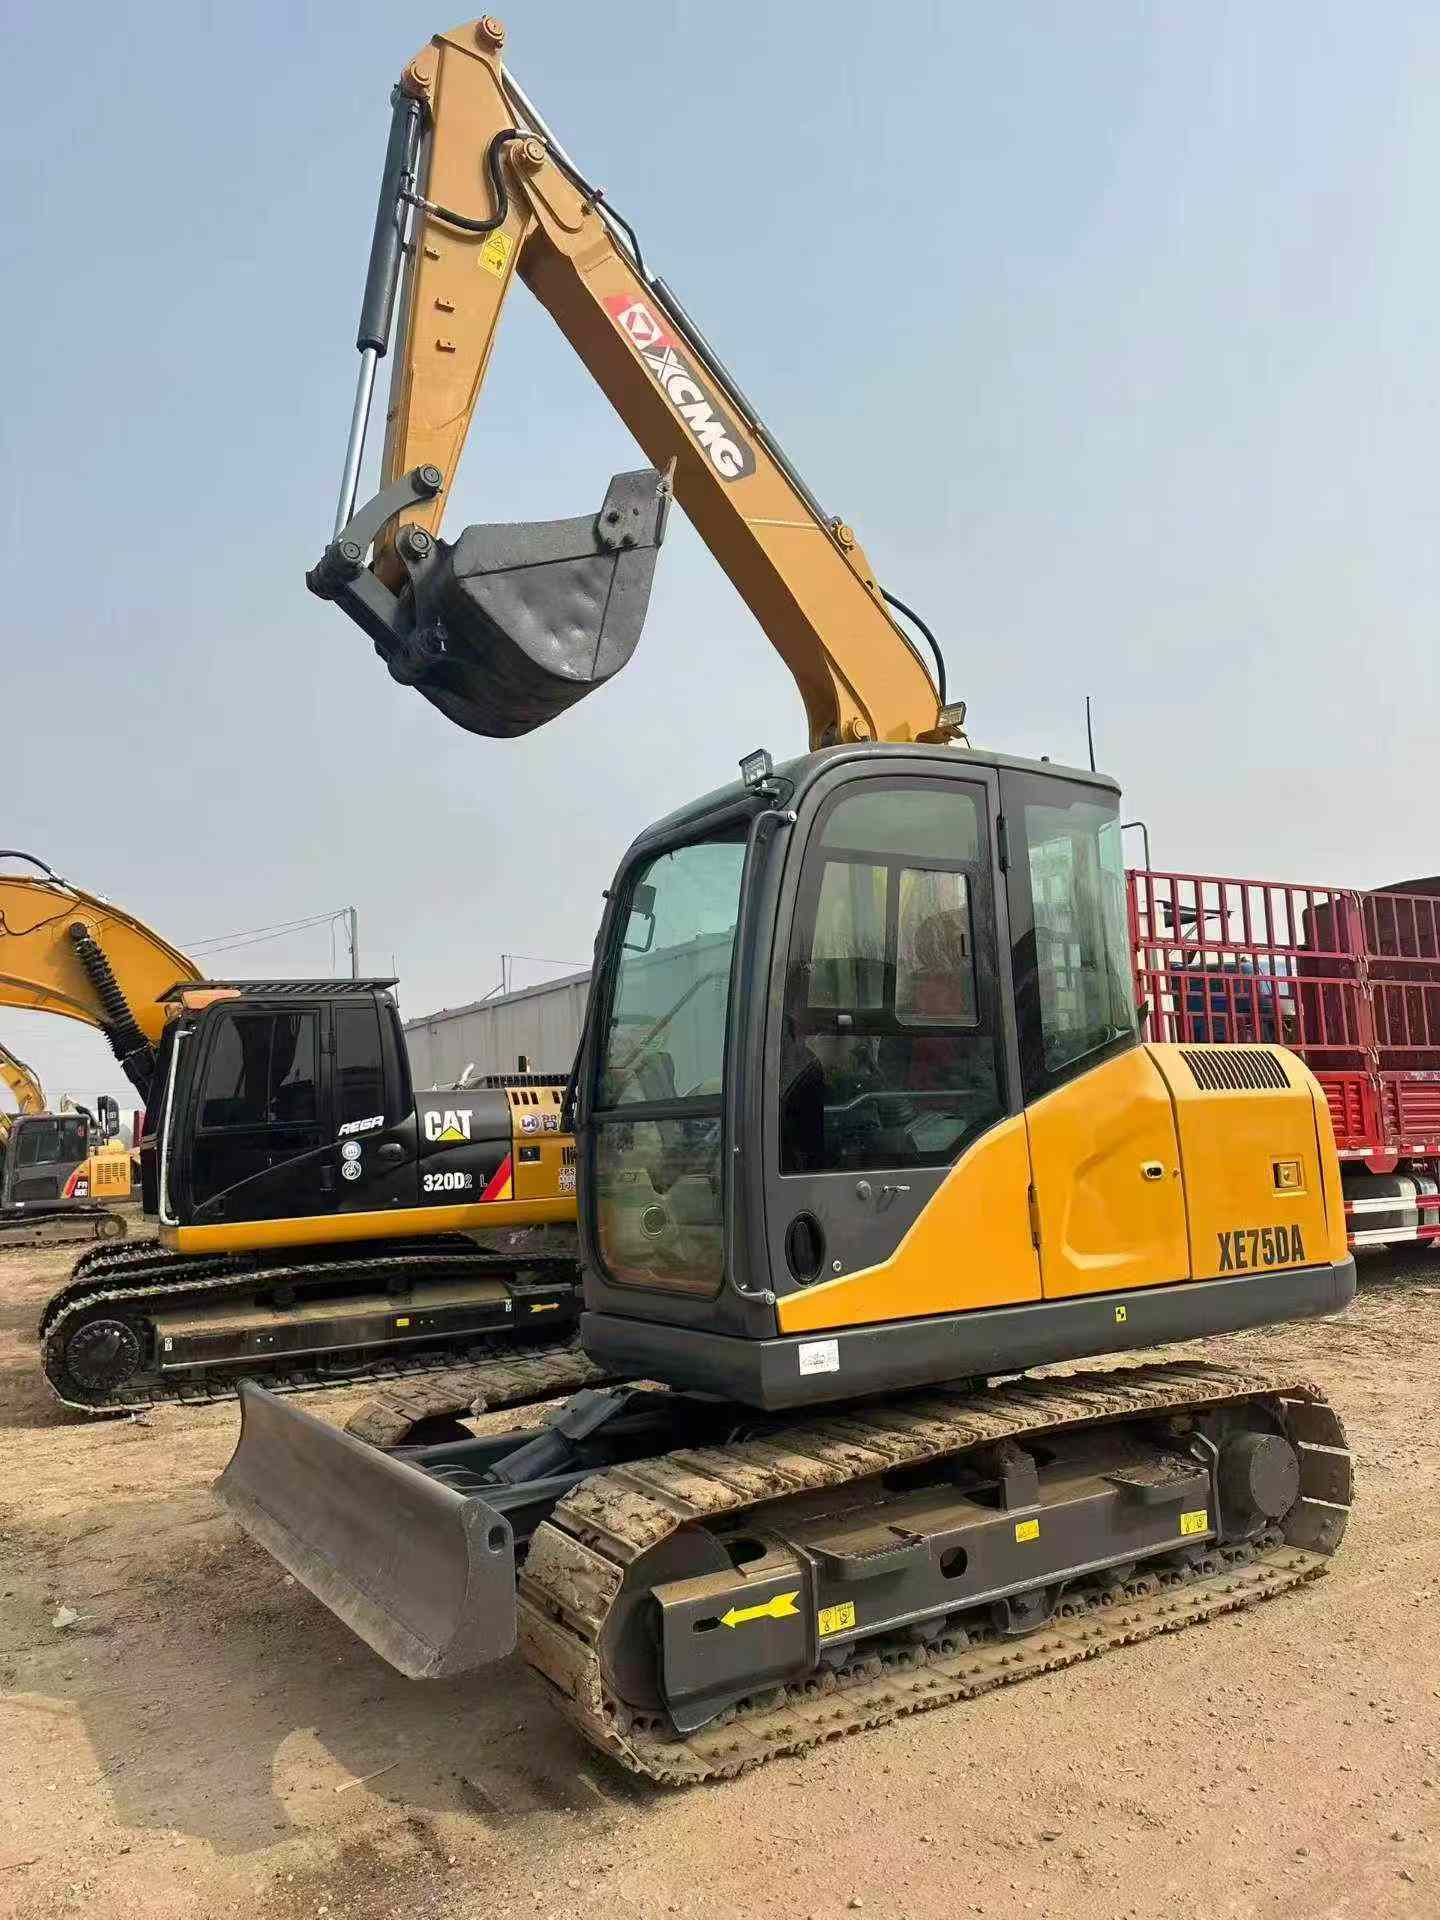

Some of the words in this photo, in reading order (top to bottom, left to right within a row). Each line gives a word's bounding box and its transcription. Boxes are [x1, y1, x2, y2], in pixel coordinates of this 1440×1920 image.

[640, 344, 745, 478] XCMG
[423, 1109, 473, 1142] CAT
[1216, 1223, 1306, 1272] XE75DA
